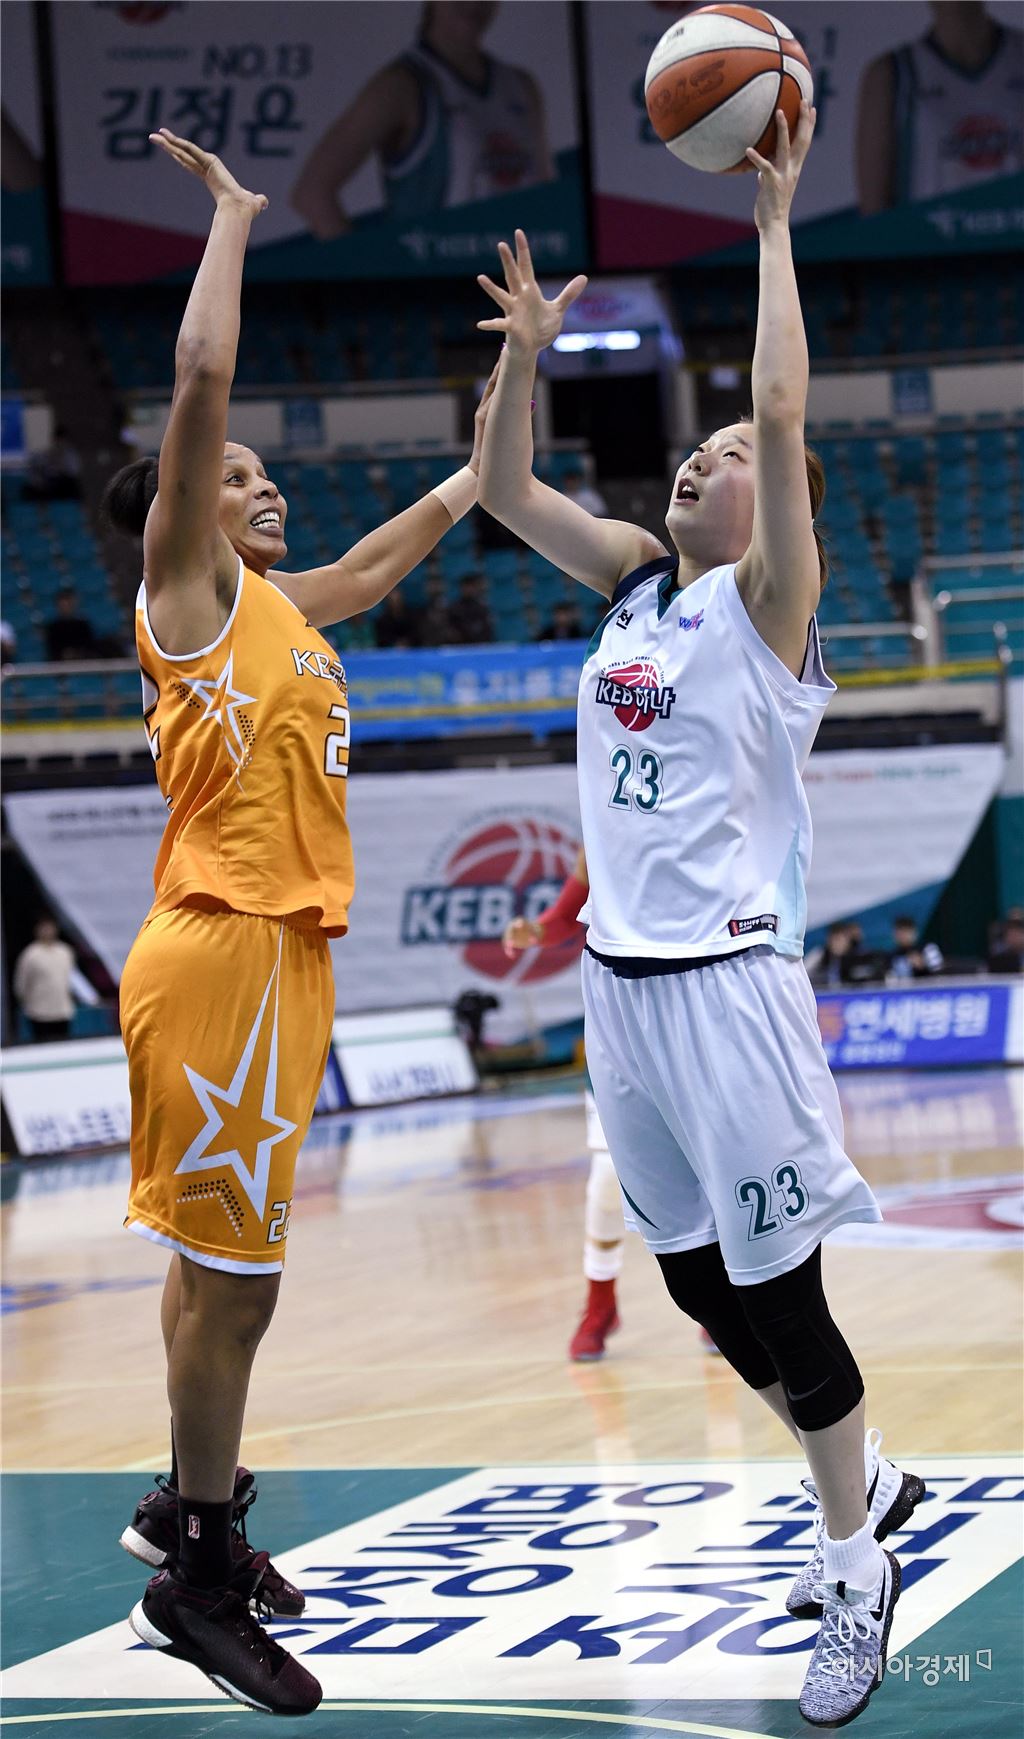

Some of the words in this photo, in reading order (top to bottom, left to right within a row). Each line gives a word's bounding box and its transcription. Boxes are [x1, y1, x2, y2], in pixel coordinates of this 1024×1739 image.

[99, 84, 305, 160] 김정은
[608, 744, 664, 814] 23
[735, 1160, 808, 1241] 23
